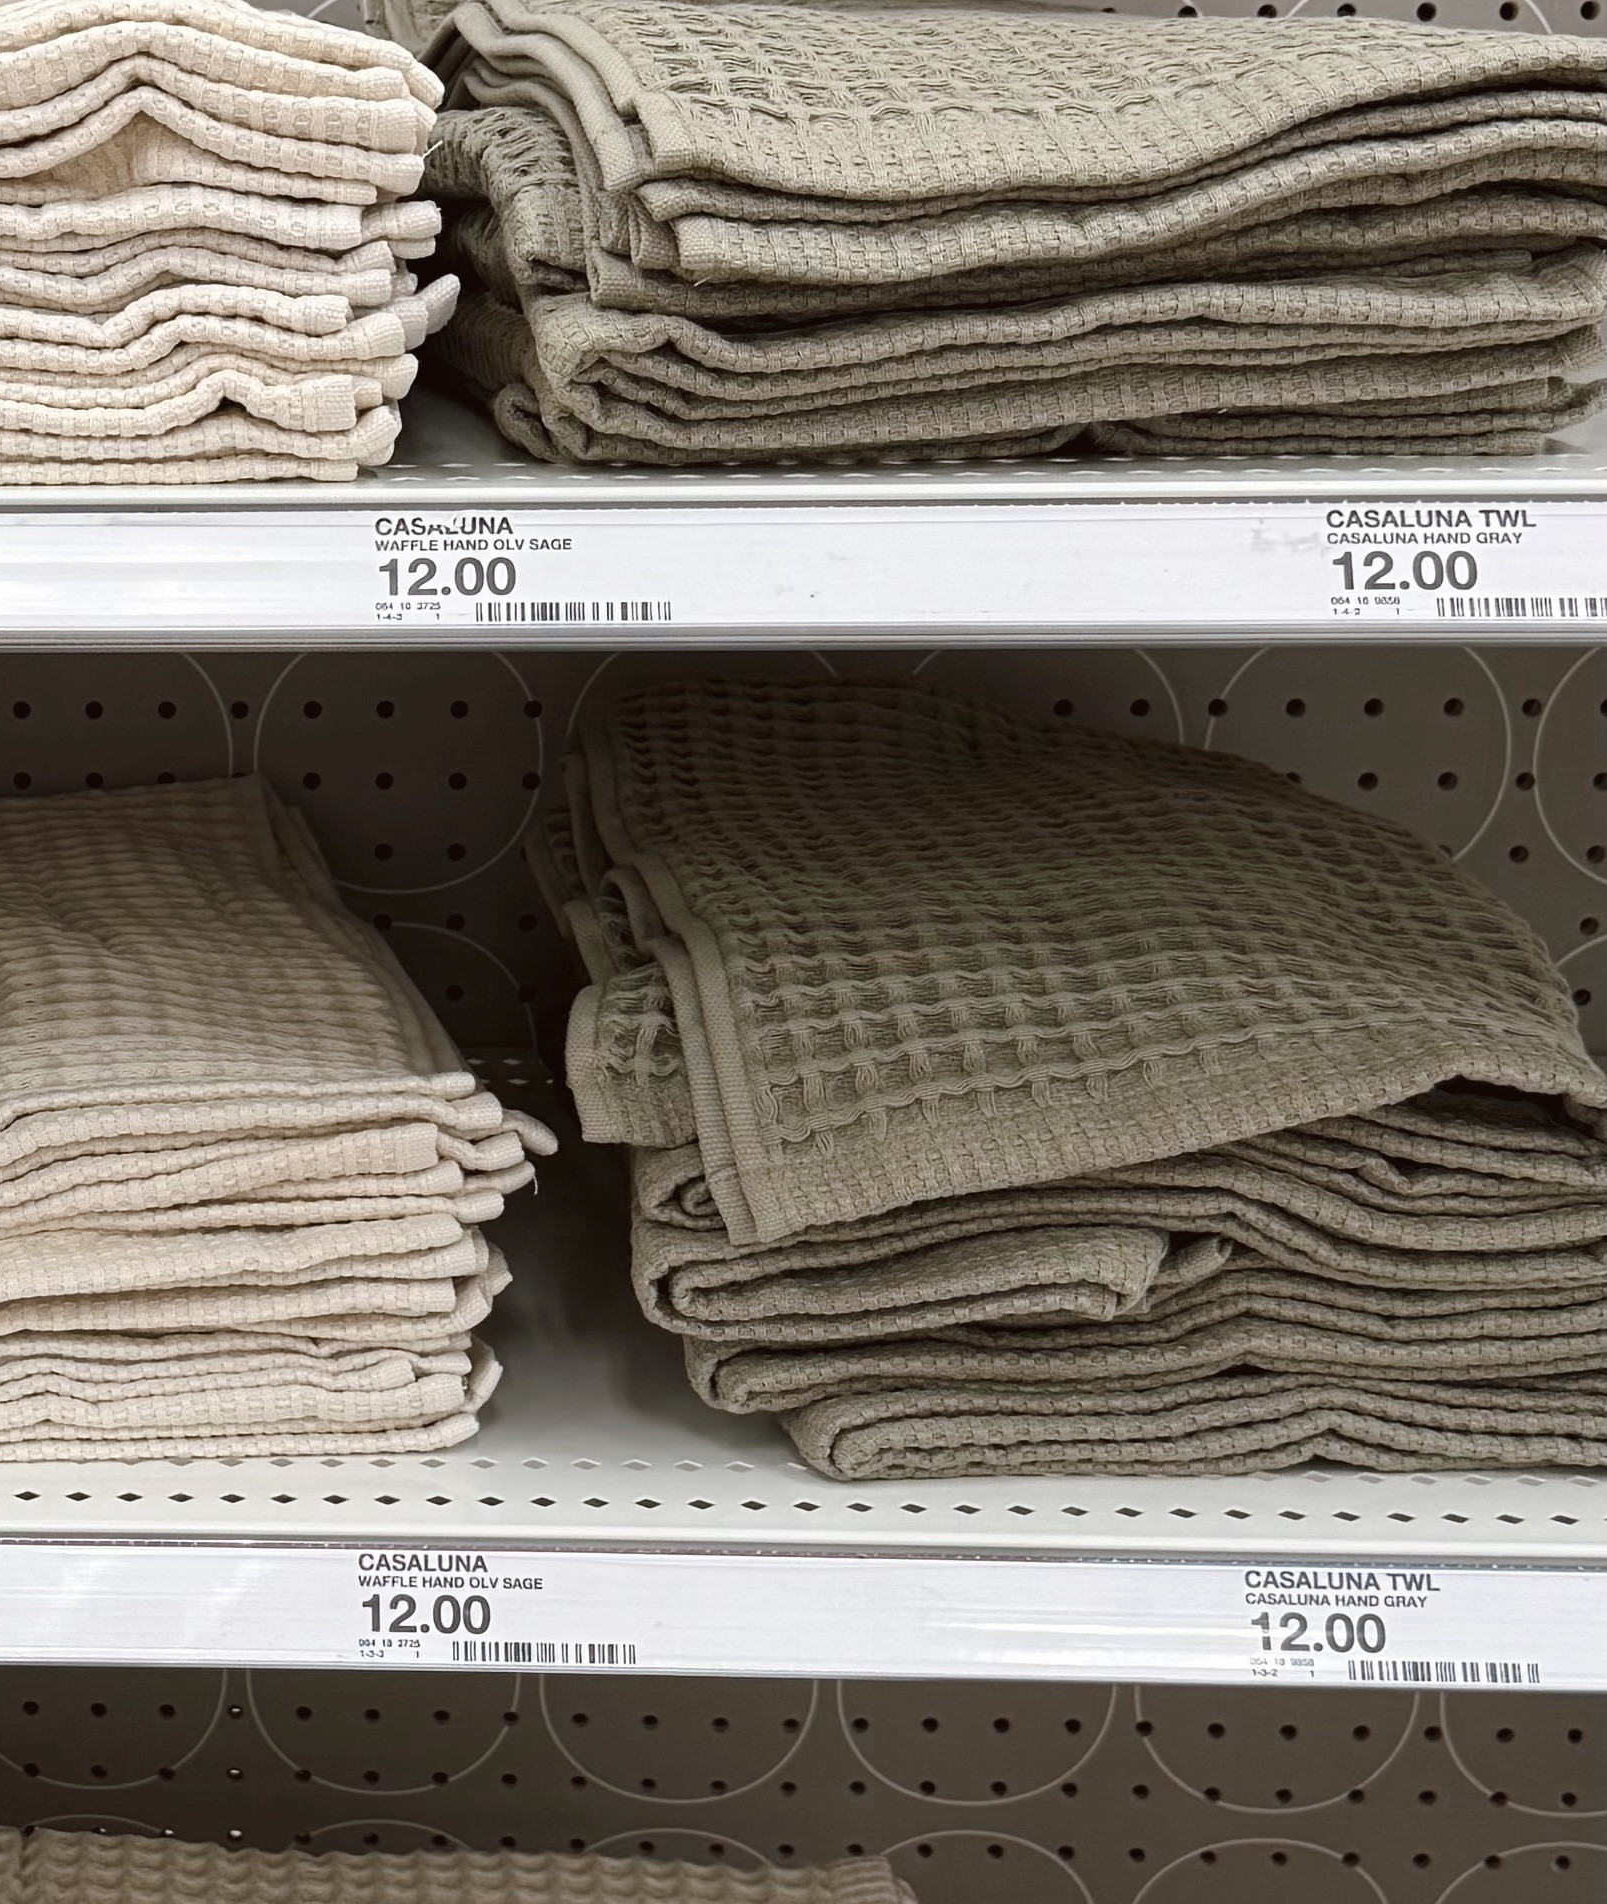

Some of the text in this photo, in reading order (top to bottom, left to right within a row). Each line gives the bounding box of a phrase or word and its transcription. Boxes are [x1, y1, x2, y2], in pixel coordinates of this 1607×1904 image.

[375, 516, 514, 535] CASALUNA
[1326, 509, 1537, 528] CASALUNA TWL
[375, 539, 573, 551] WAFFLE HAND OLV SAGE
[1327, 533, 1523, 544] CASALUNA HAND GRAY
[379, 557, 517, 596] 12.00
[1332, 550, 1478, 591] 12.00
[358, 1553, 488, 1573] CASALUNA
[358, 1575, 543, 1590] WAFFLE HAND OLV SAGE
[1245, 1570, 1441, 1592] CASALUNA TWL
[1245, 1593, 1427, 1608] CASALUNA HAND GRAY
[362, 1594, 491, 1635] 12.00
[1251, 1612, 1386, 1654] 12.00
